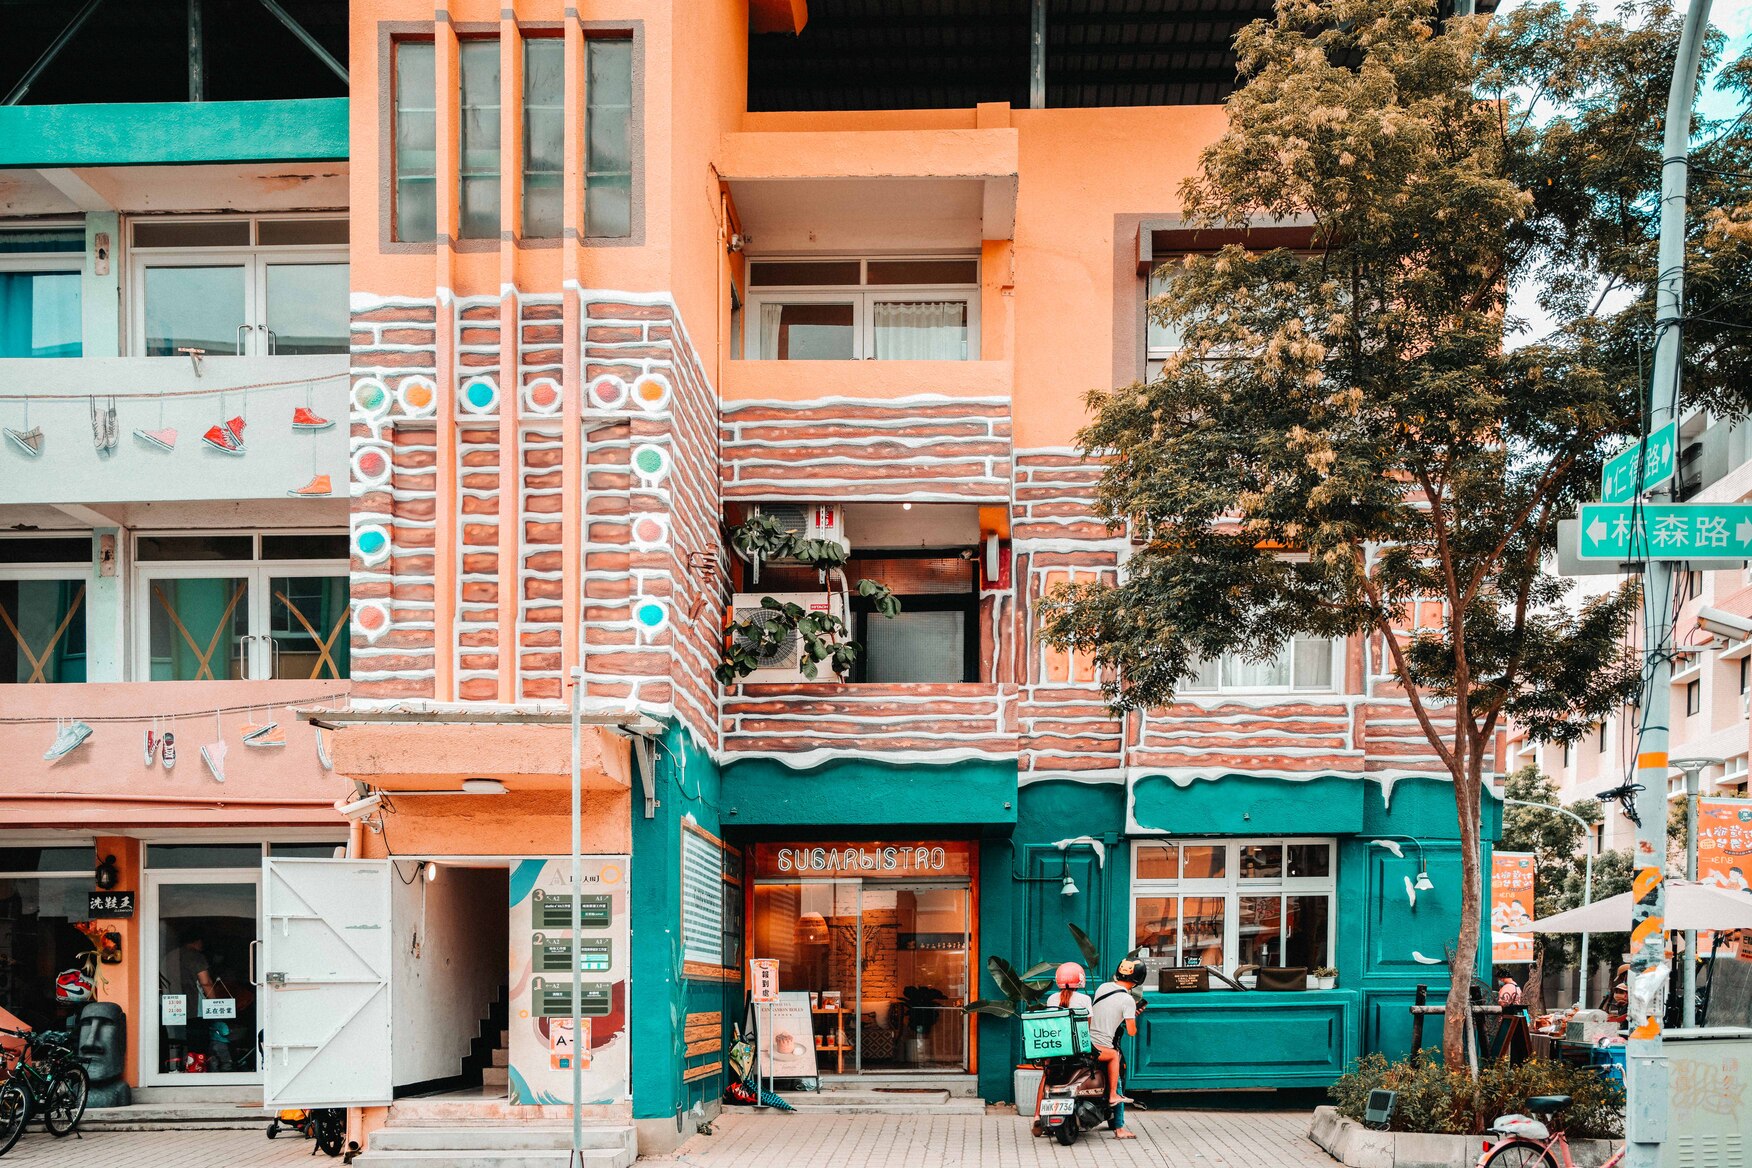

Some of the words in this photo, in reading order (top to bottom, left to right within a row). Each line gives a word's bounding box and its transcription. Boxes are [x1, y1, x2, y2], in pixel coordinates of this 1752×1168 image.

[1613, 443, 1661, 498] 仁德路
[1611, 513, 1731, 548] 林森路
[534, 889, 544, 901] 3
[90, 896, 133, 909] 洗鞋王
[533, 933, 543, 945] 2
[534, 978, 543, 990] 1
[1033, 1028, 1062, 1038] Uber
[1034, 1039, 1062, 1049] Eats
